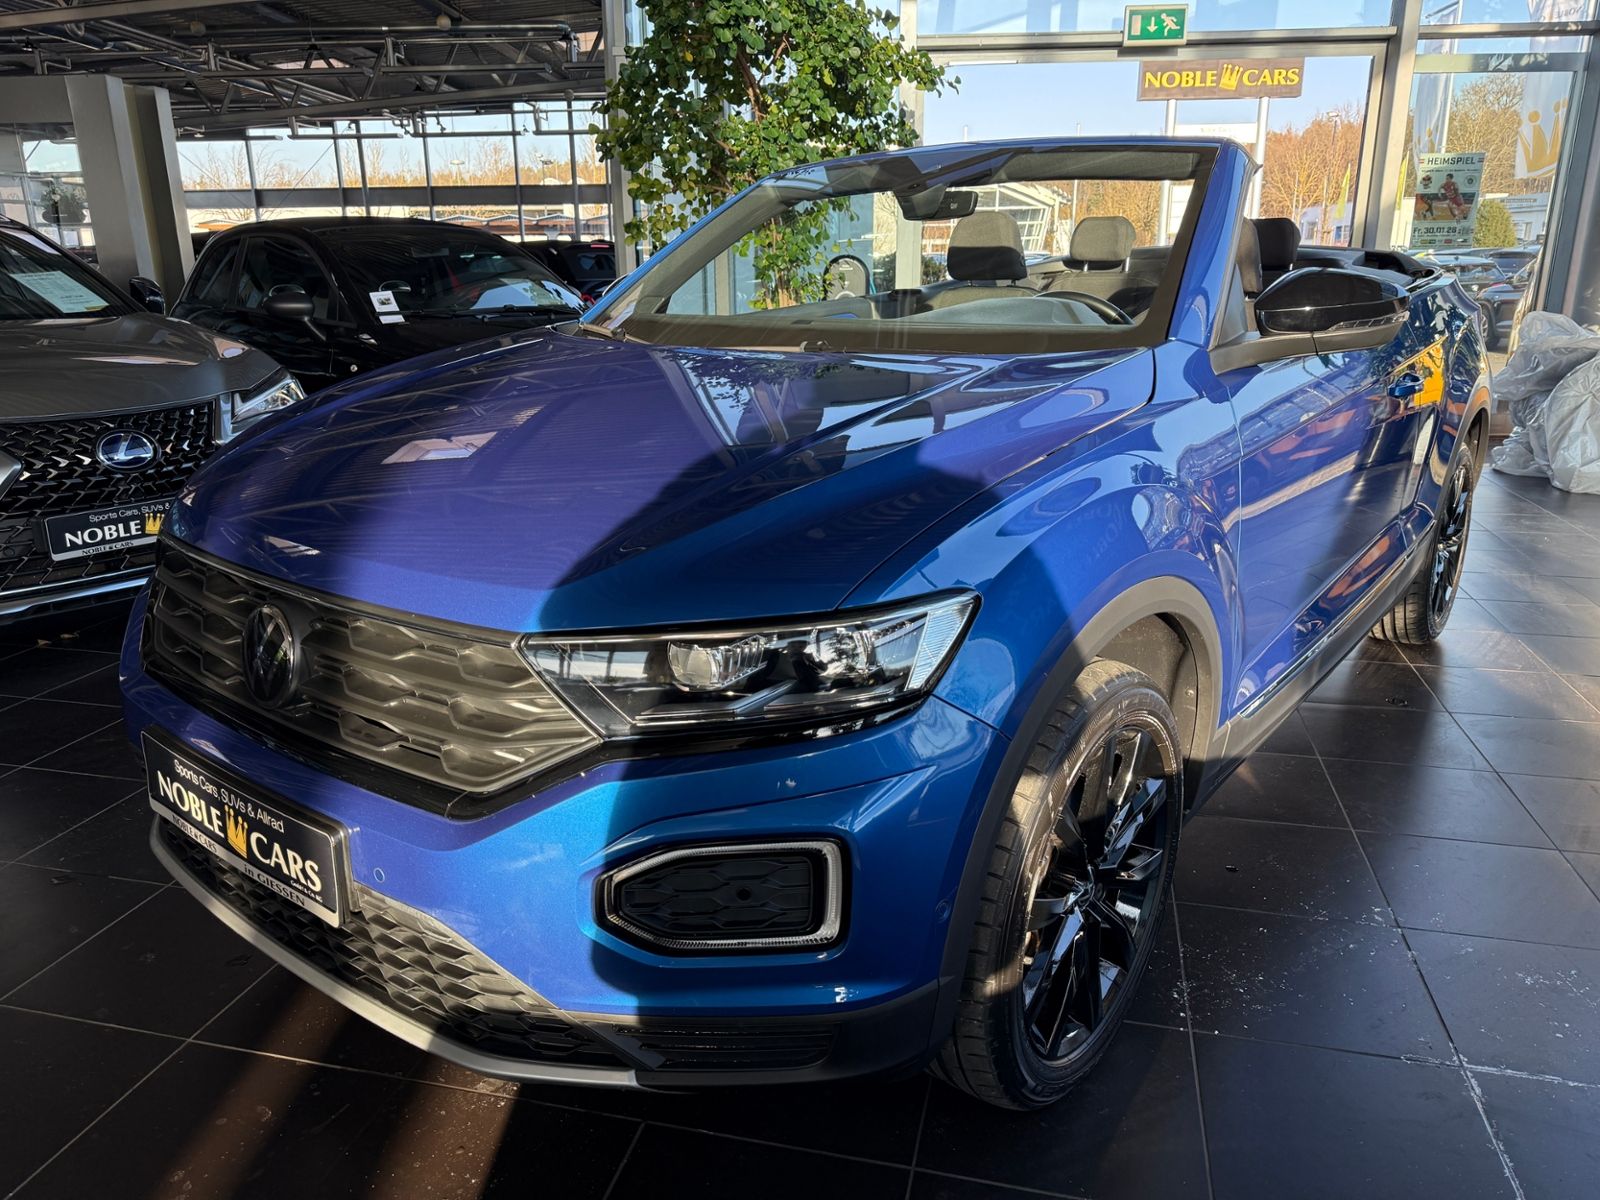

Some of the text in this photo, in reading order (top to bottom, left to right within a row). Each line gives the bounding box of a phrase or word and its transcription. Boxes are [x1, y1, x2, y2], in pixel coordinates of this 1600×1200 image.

[1144, 68, 1300, 88] NOBLE CARS
[1427, 156, 1476, 165] HEIMSPIEL
[88, 502, 171, 523] Sports Cars, SUVs &
[64, 520, 142, 547] NOBLE
[114, 541, 134, 550] CARS
[174, 759, 285, 834] Sports Cars, SUVs & Allrad
[157, 770, 322, 892] NOBLE CARS
[243, 863, 255, 878] in
[256, 871, 306, 907] GIESSEN
